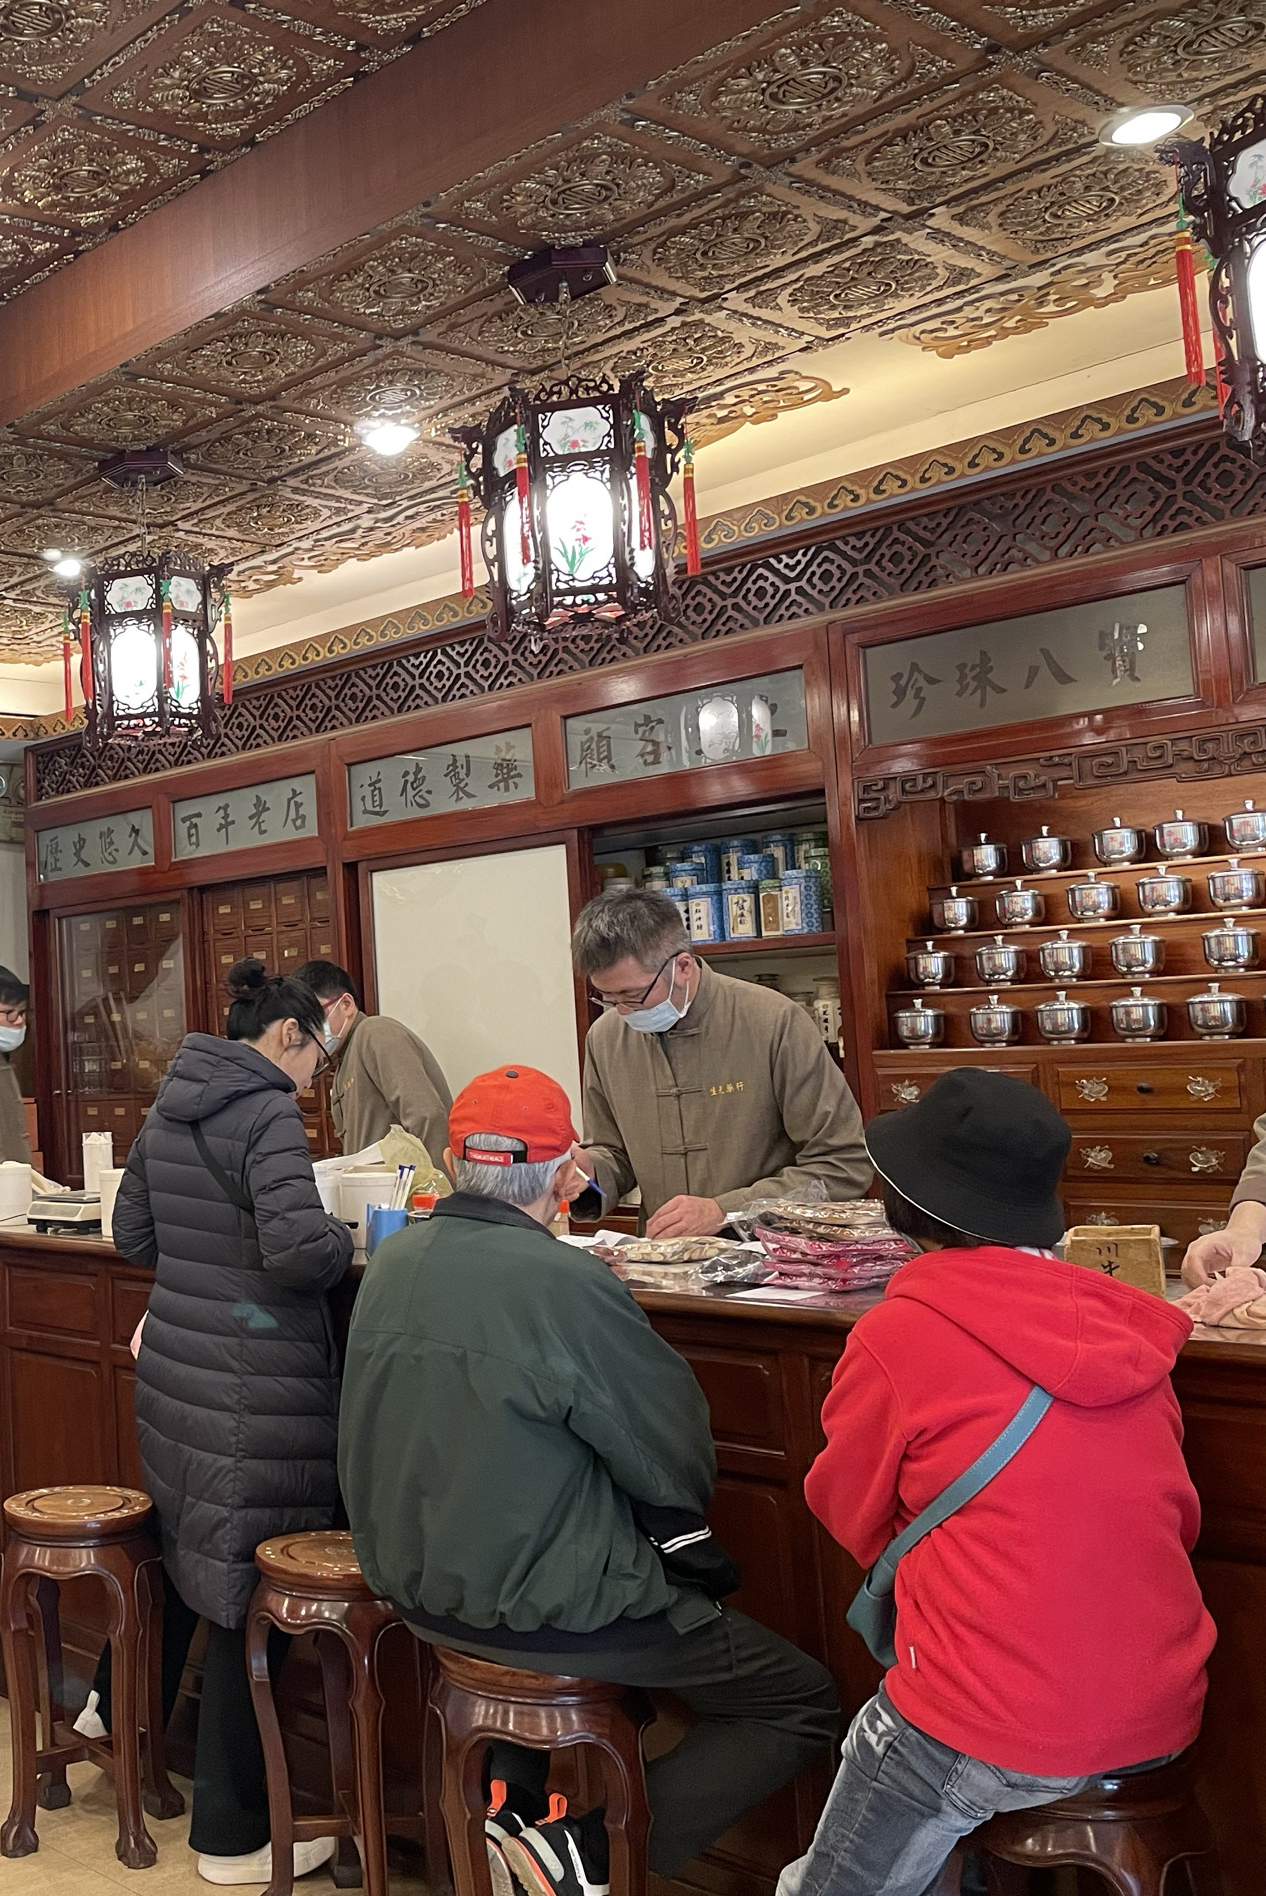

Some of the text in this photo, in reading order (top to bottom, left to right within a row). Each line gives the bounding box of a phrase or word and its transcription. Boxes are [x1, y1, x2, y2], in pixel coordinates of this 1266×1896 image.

[578, 694, 788, 778] 顧客
[359, 740, 524, 818] 道德製藥
[43, 822, 150, 873] 歷史悠久
[180, 787, 307, 849] 百年老店
